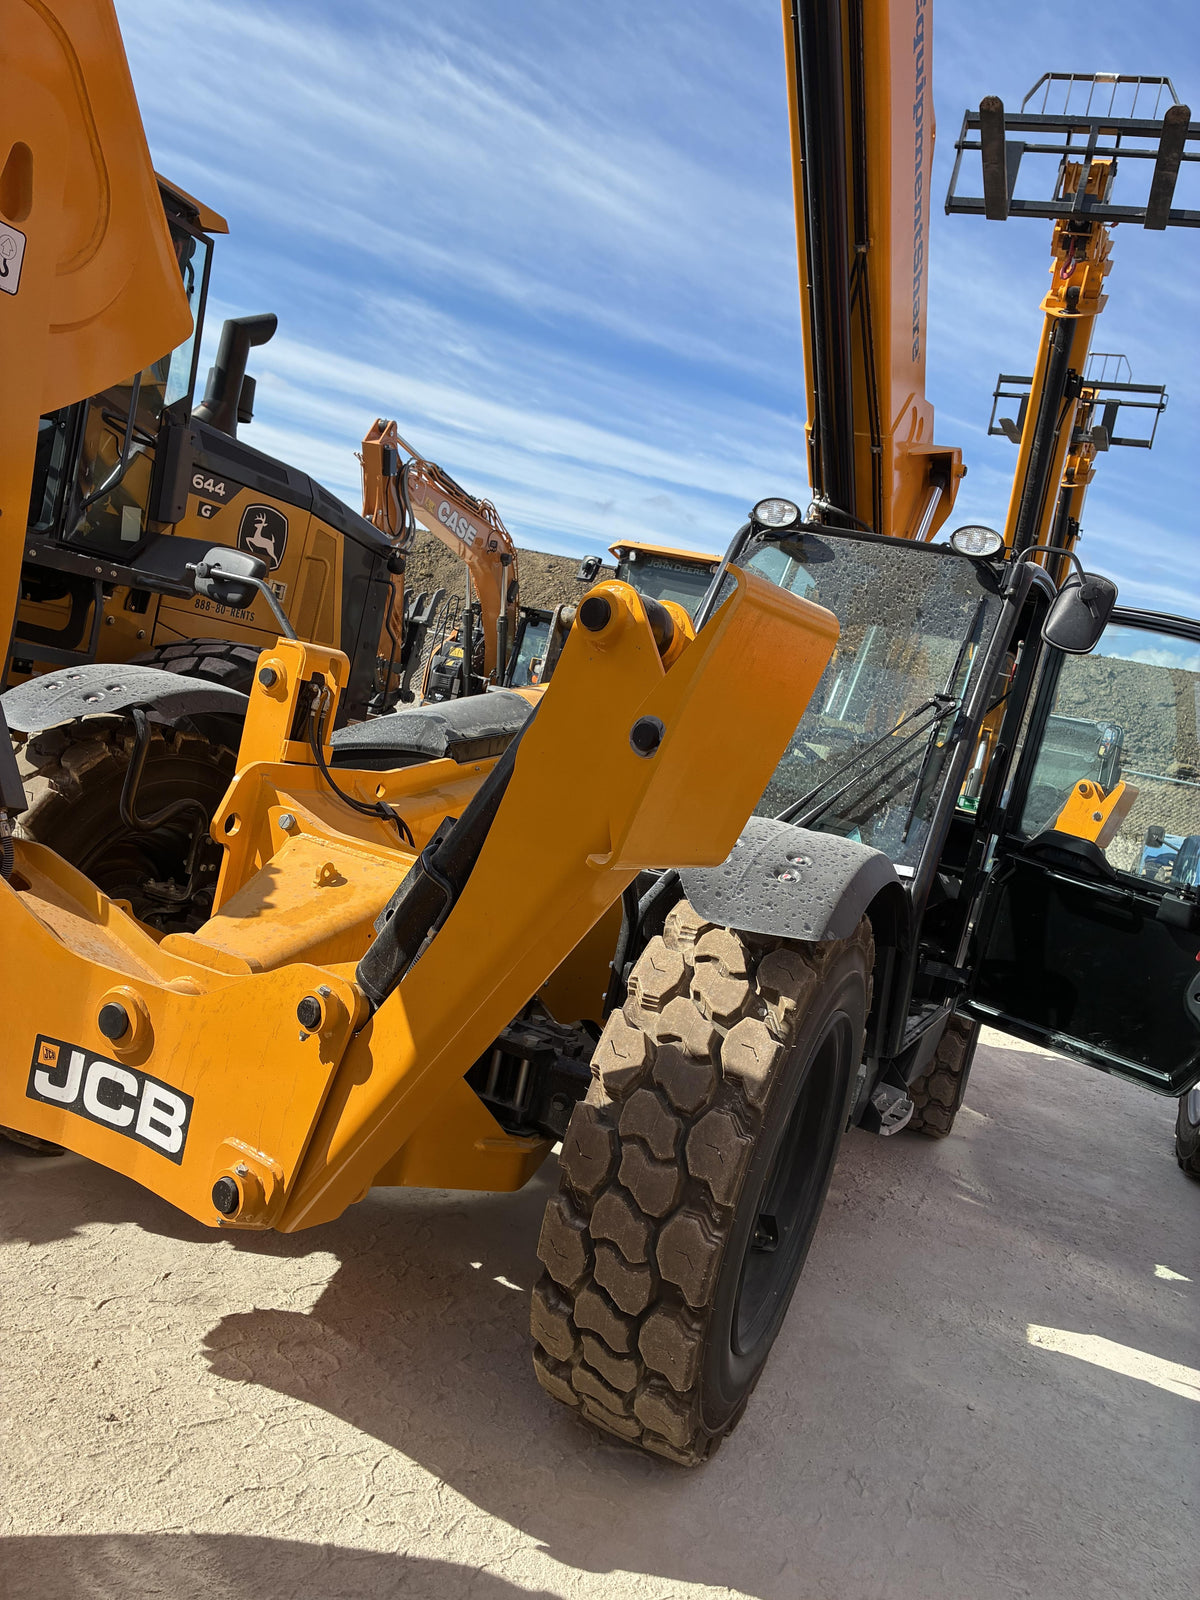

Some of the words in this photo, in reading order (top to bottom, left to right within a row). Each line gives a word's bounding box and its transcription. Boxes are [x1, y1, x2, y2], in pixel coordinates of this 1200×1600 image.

[192, 474, 226, 497] 644
[201, 504, 212, 518] G
[437, 501, 478, 547] CASE
[647, 560, 673, 570] JOHN
[674, 564, 707, 576] DEERE
[194, 598, 255, 622] 888-80-RENTS
[34, 1050, 187, 1154] JCB
